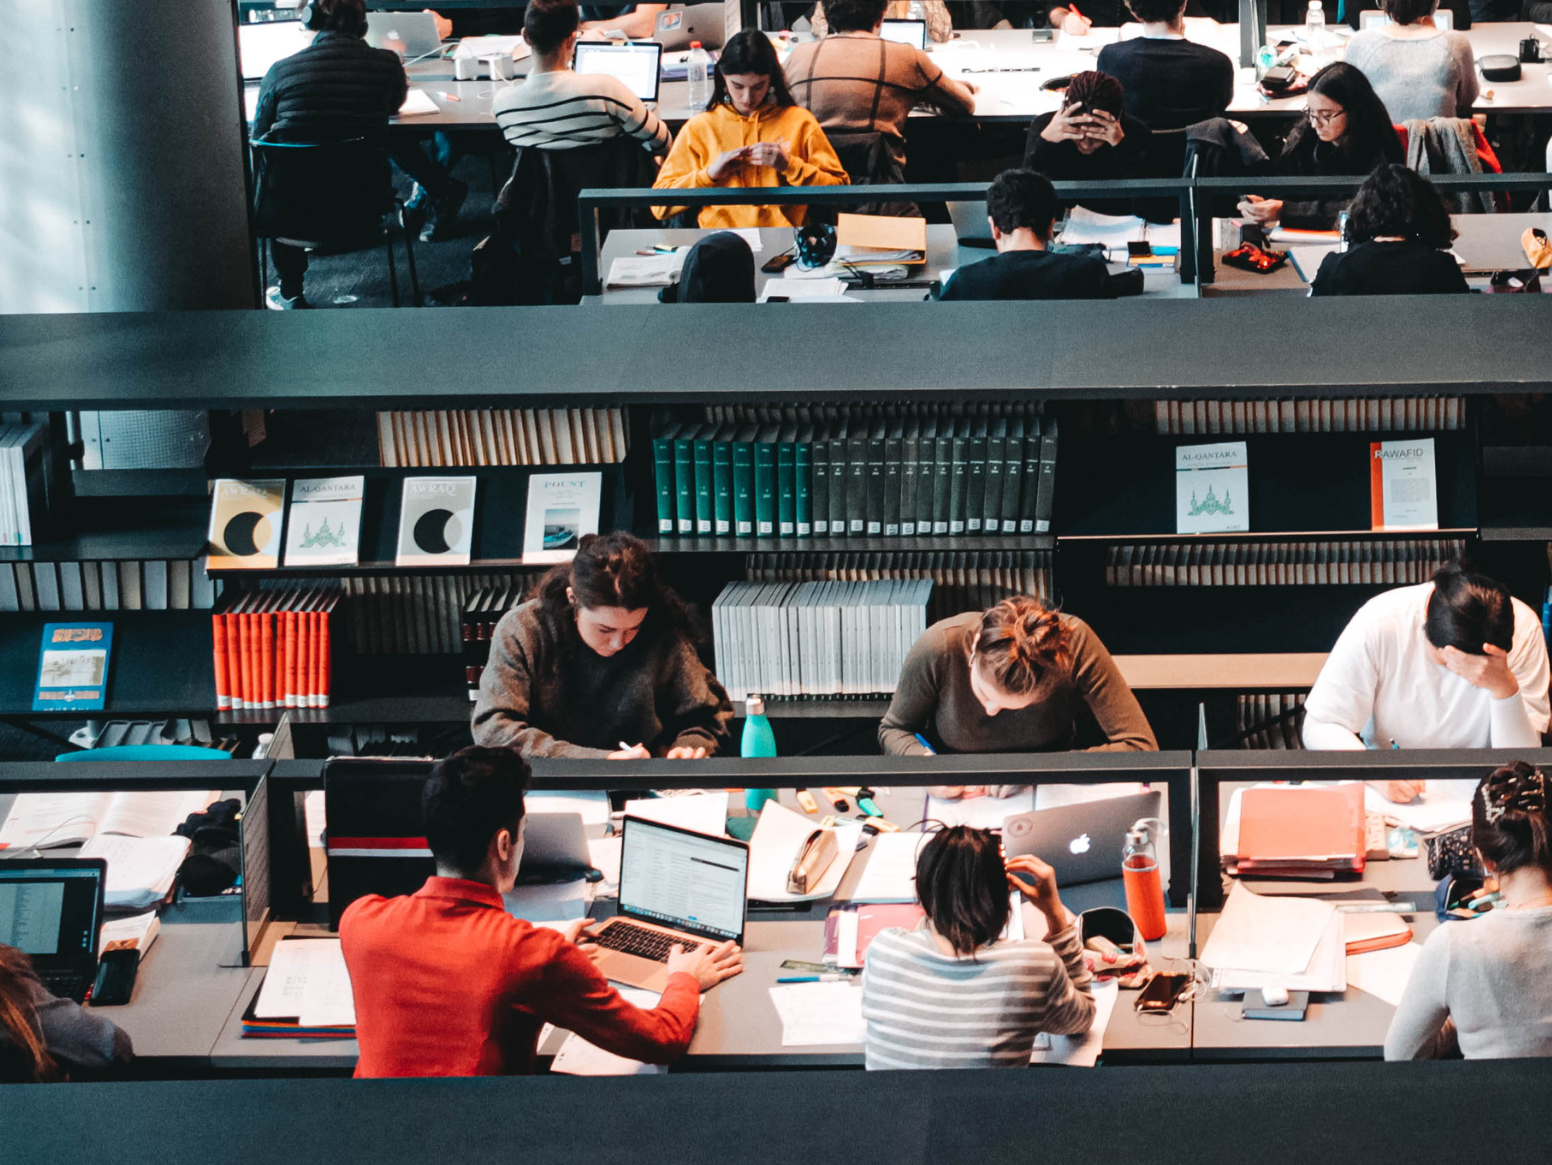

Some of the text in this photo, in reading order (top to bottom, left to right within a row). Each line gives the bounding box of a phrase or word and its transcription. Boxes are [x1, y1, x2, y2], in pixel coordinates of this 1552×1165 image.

[1182, 450, 1237, 461] AL-QANTARA
[1374, 448, 1424, 459] RAWAFID
[300, 483, 356, 493] AL-QANTARA
[410, 483, 457, 497] AWRAQ
